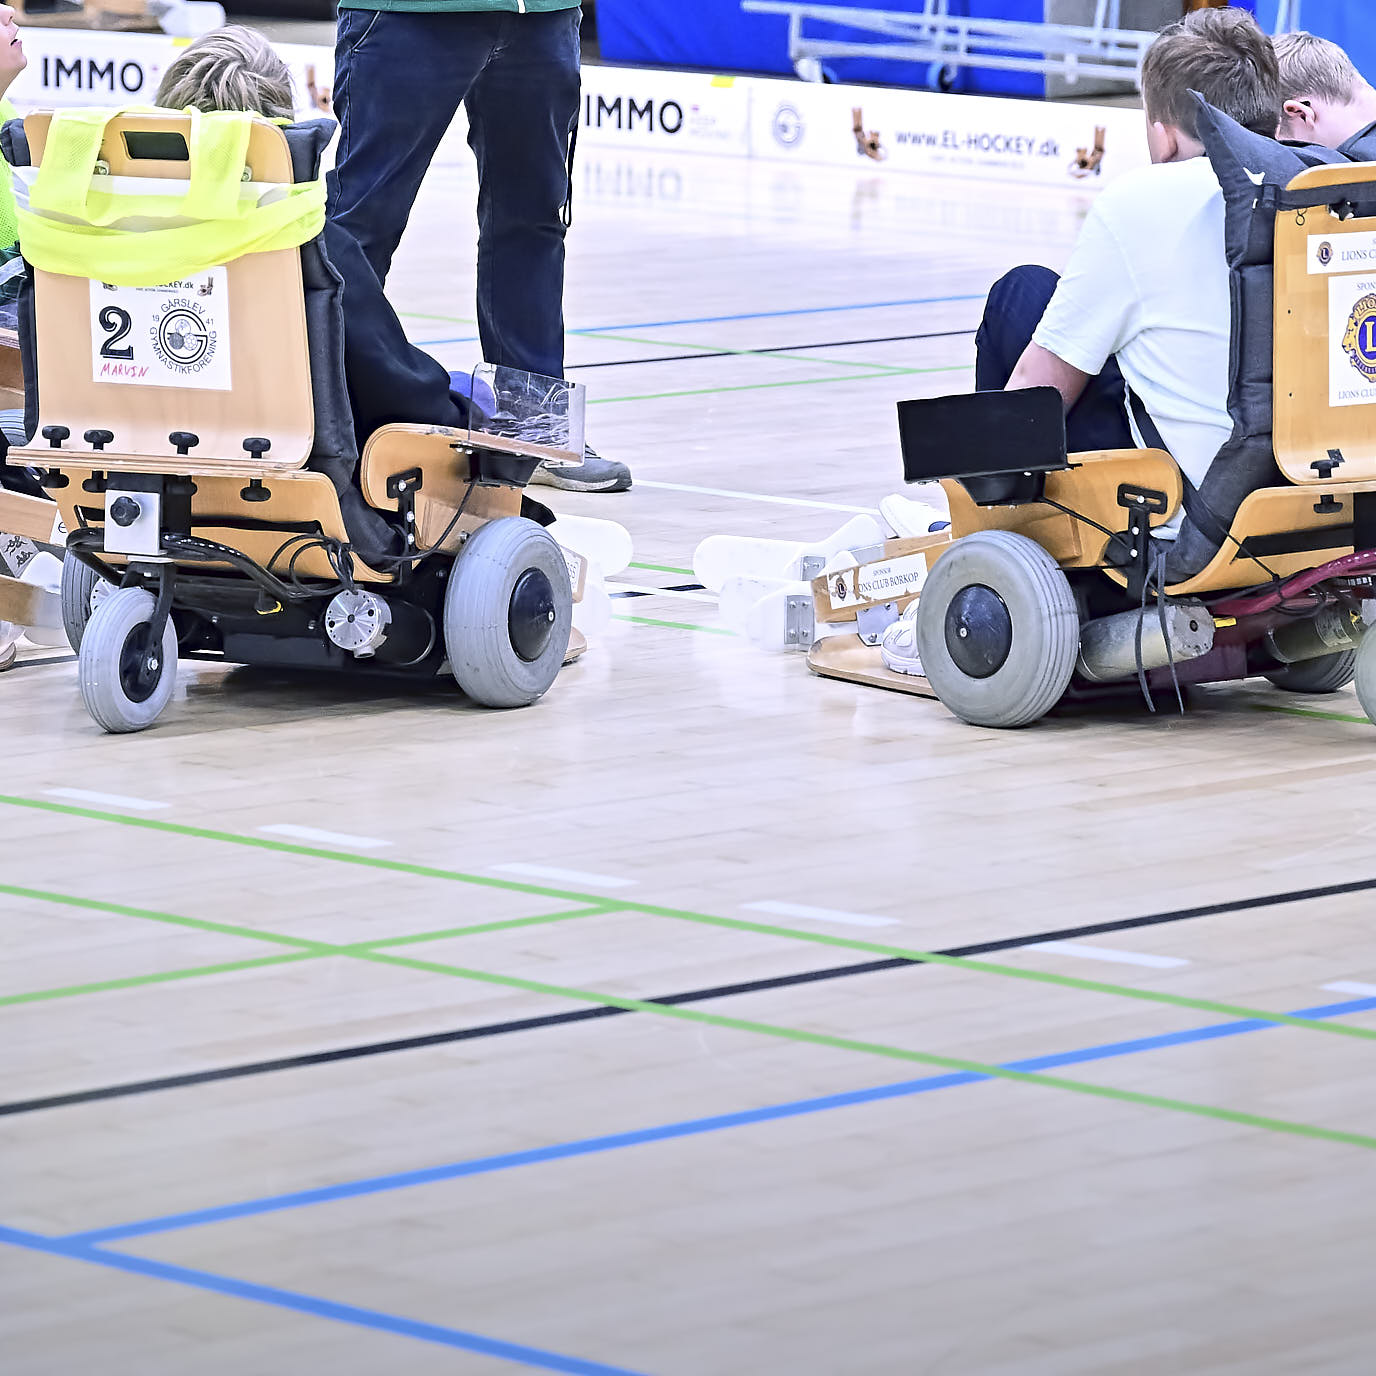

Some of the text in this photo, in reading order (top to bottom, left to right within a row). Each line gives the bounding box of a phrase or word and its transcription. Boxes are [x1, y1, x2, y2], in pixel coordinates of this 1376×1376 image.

[41, 57, 144, 92] IMMO
[585, 94, 684, 134] IMMO
[896, 129, 1060, 157] www.EL-HOCKEY.dk
[1341, 250, 1367, 261] LIONS
[160, 298, 206, 315] GÅRSLEV
[98, 305, 134, 360] 2
[149, 326, 217, 375] GYMNASTIKFORENING
[100, 362, 150, 377] MARVIN
[1338, 390, 1359, 400] LIONS
[872, 579, 889, 591] CLUB
